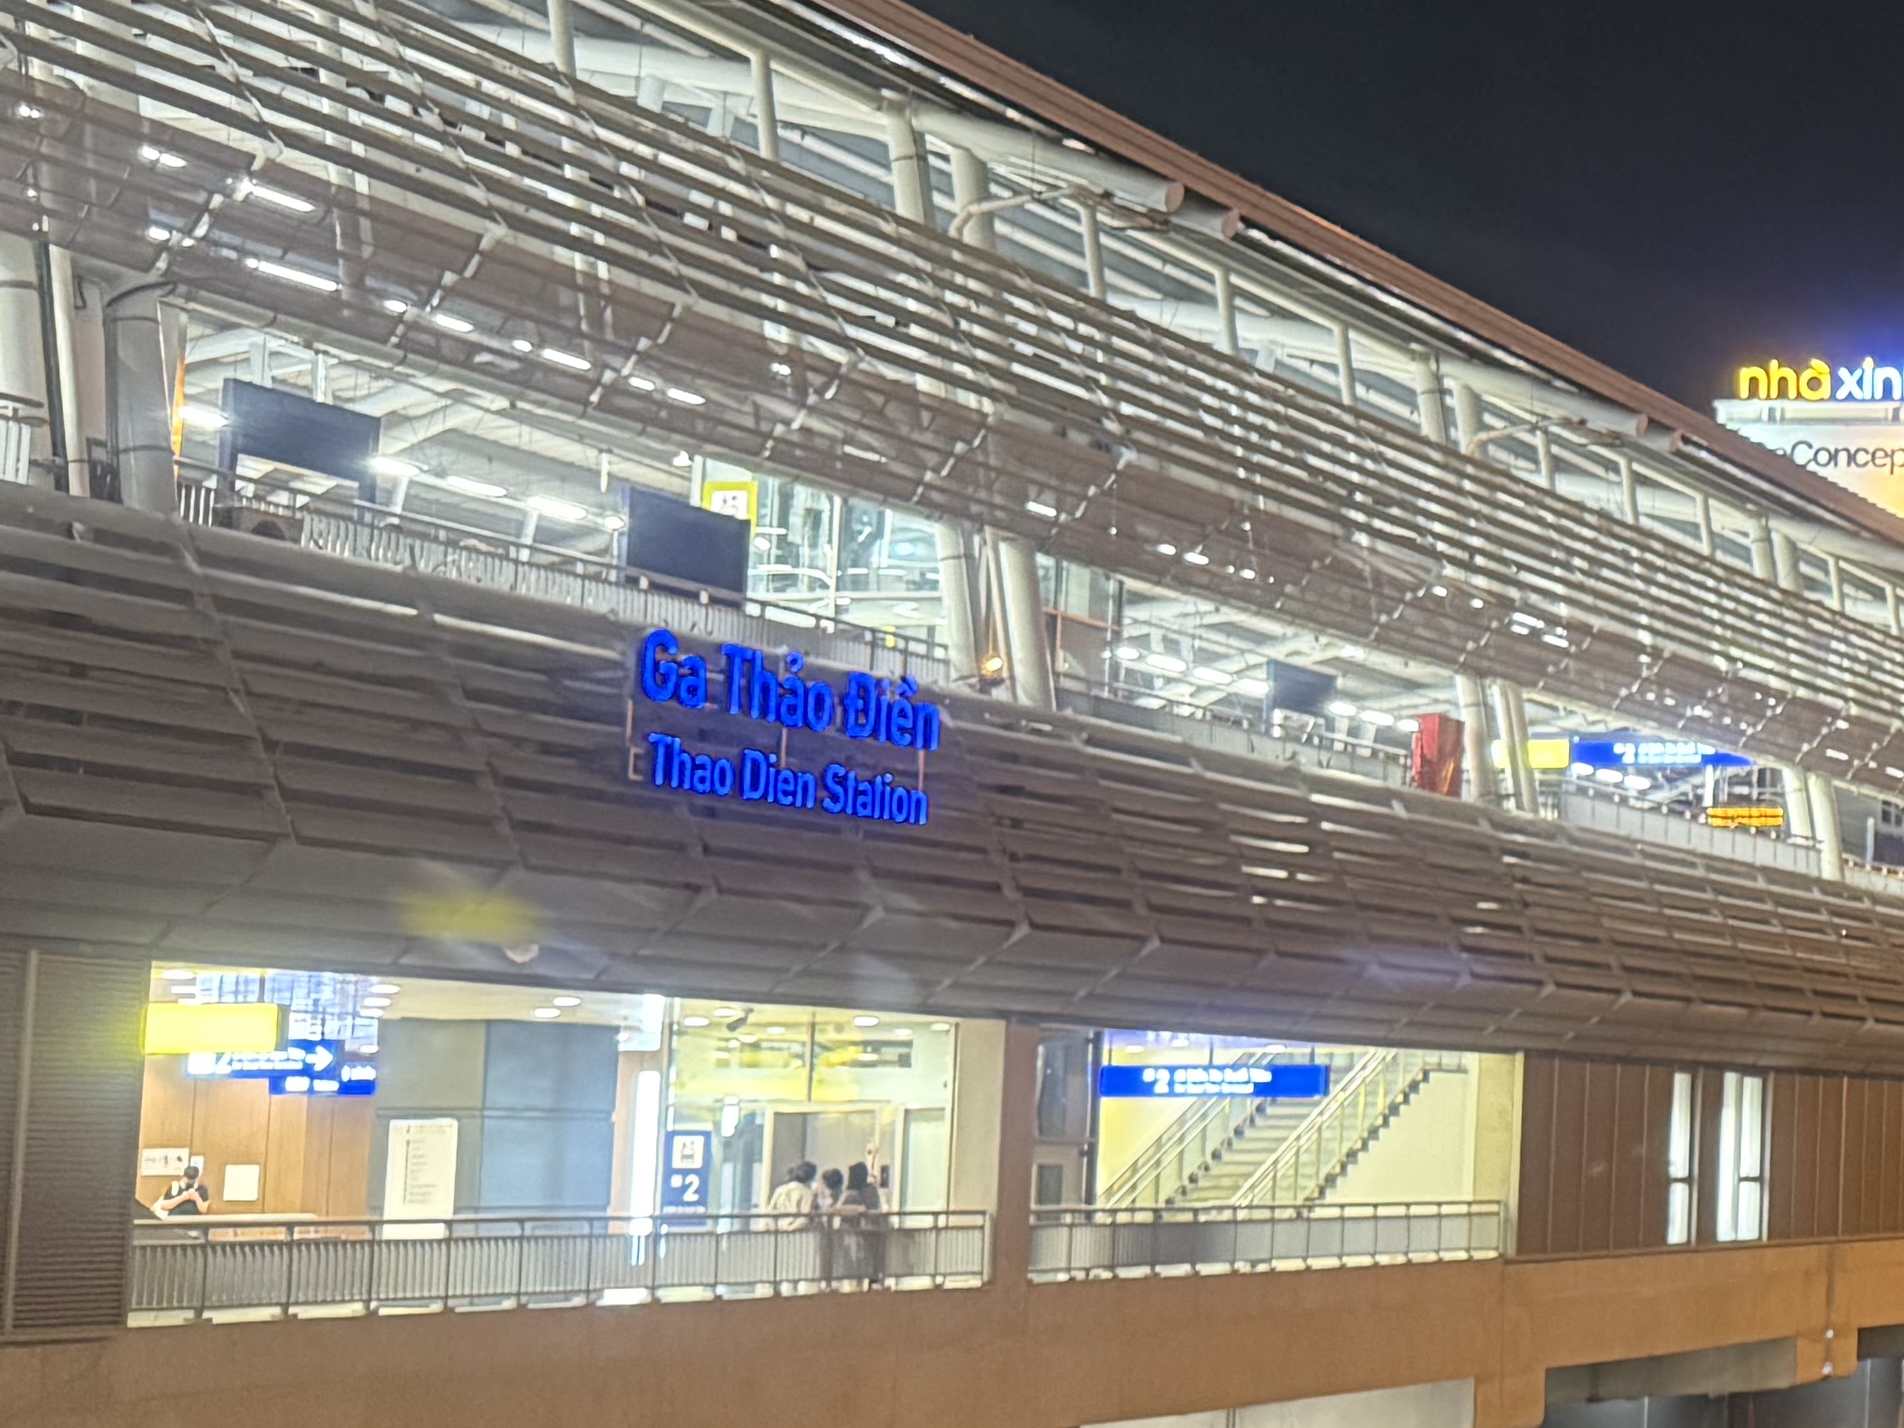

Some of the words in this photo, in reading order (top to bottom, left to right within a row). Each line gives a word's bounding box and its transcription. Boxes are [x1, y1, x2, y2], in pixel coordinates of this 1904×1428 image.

[1738, 358, 1832, 401] nhà
[641, 628, 707, 708] Ga
[721, 642, 835, 732] Thảo
[844, 672, 941, 752] Điền
[648, 732, 735, 797] Thao
[742, 748, 817, 810] Dien
[821, 763, 929, 826] Station
[682, 1173, 700, 1202] 2
